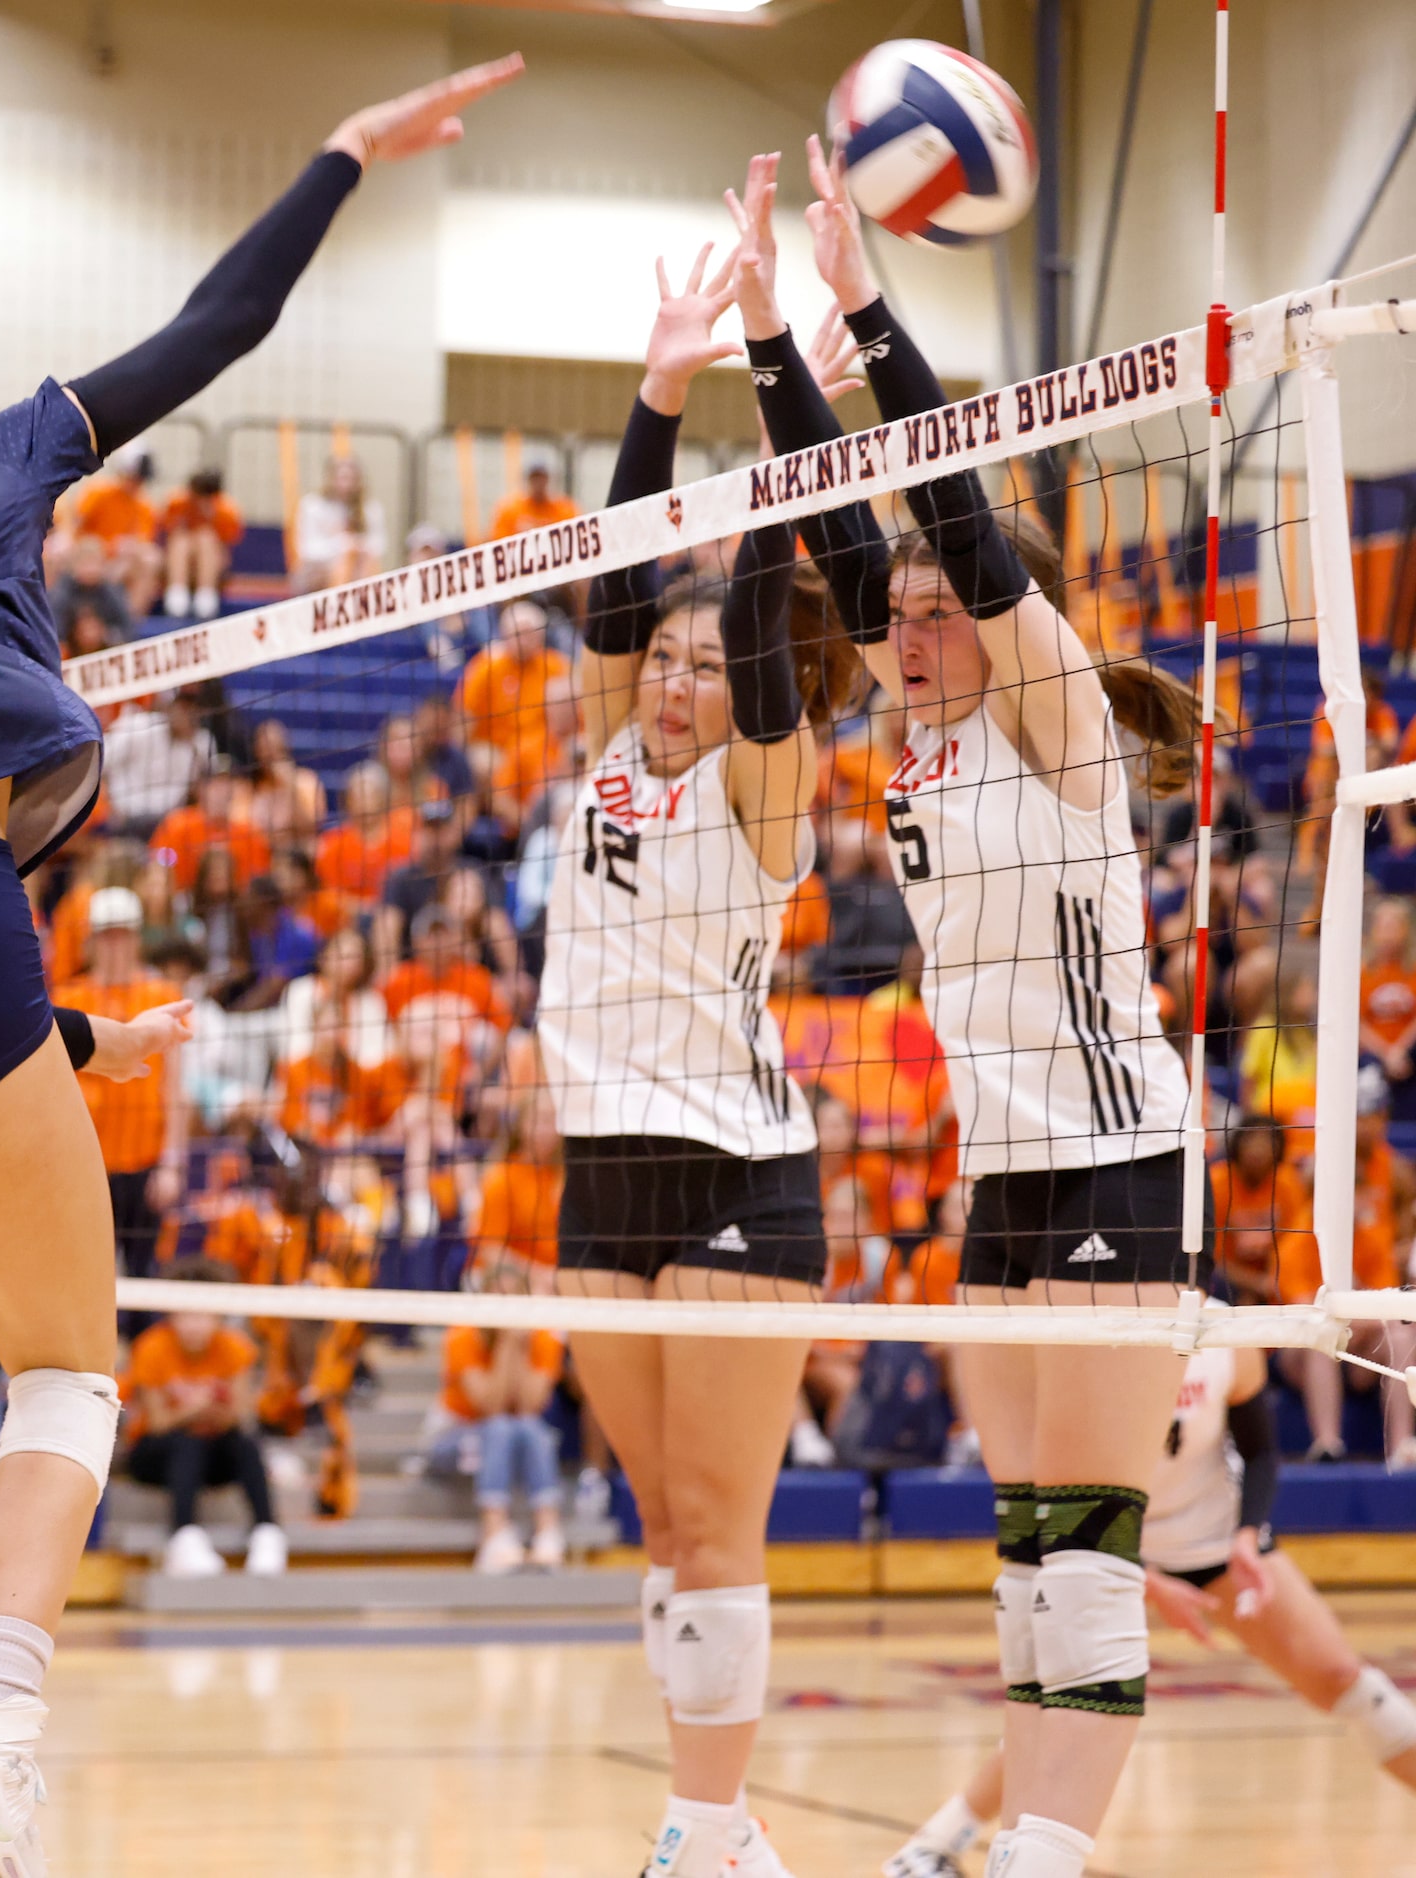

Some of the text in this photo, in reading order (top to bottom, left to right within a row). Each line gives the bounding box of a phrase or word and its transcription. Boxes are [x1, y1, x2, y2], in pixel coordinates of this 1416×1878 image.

[903, 392, 1001, 468] NORTH
[1015, 336, 1177, 435] BULLDOGS
[886, 800, 931, 881] 5
